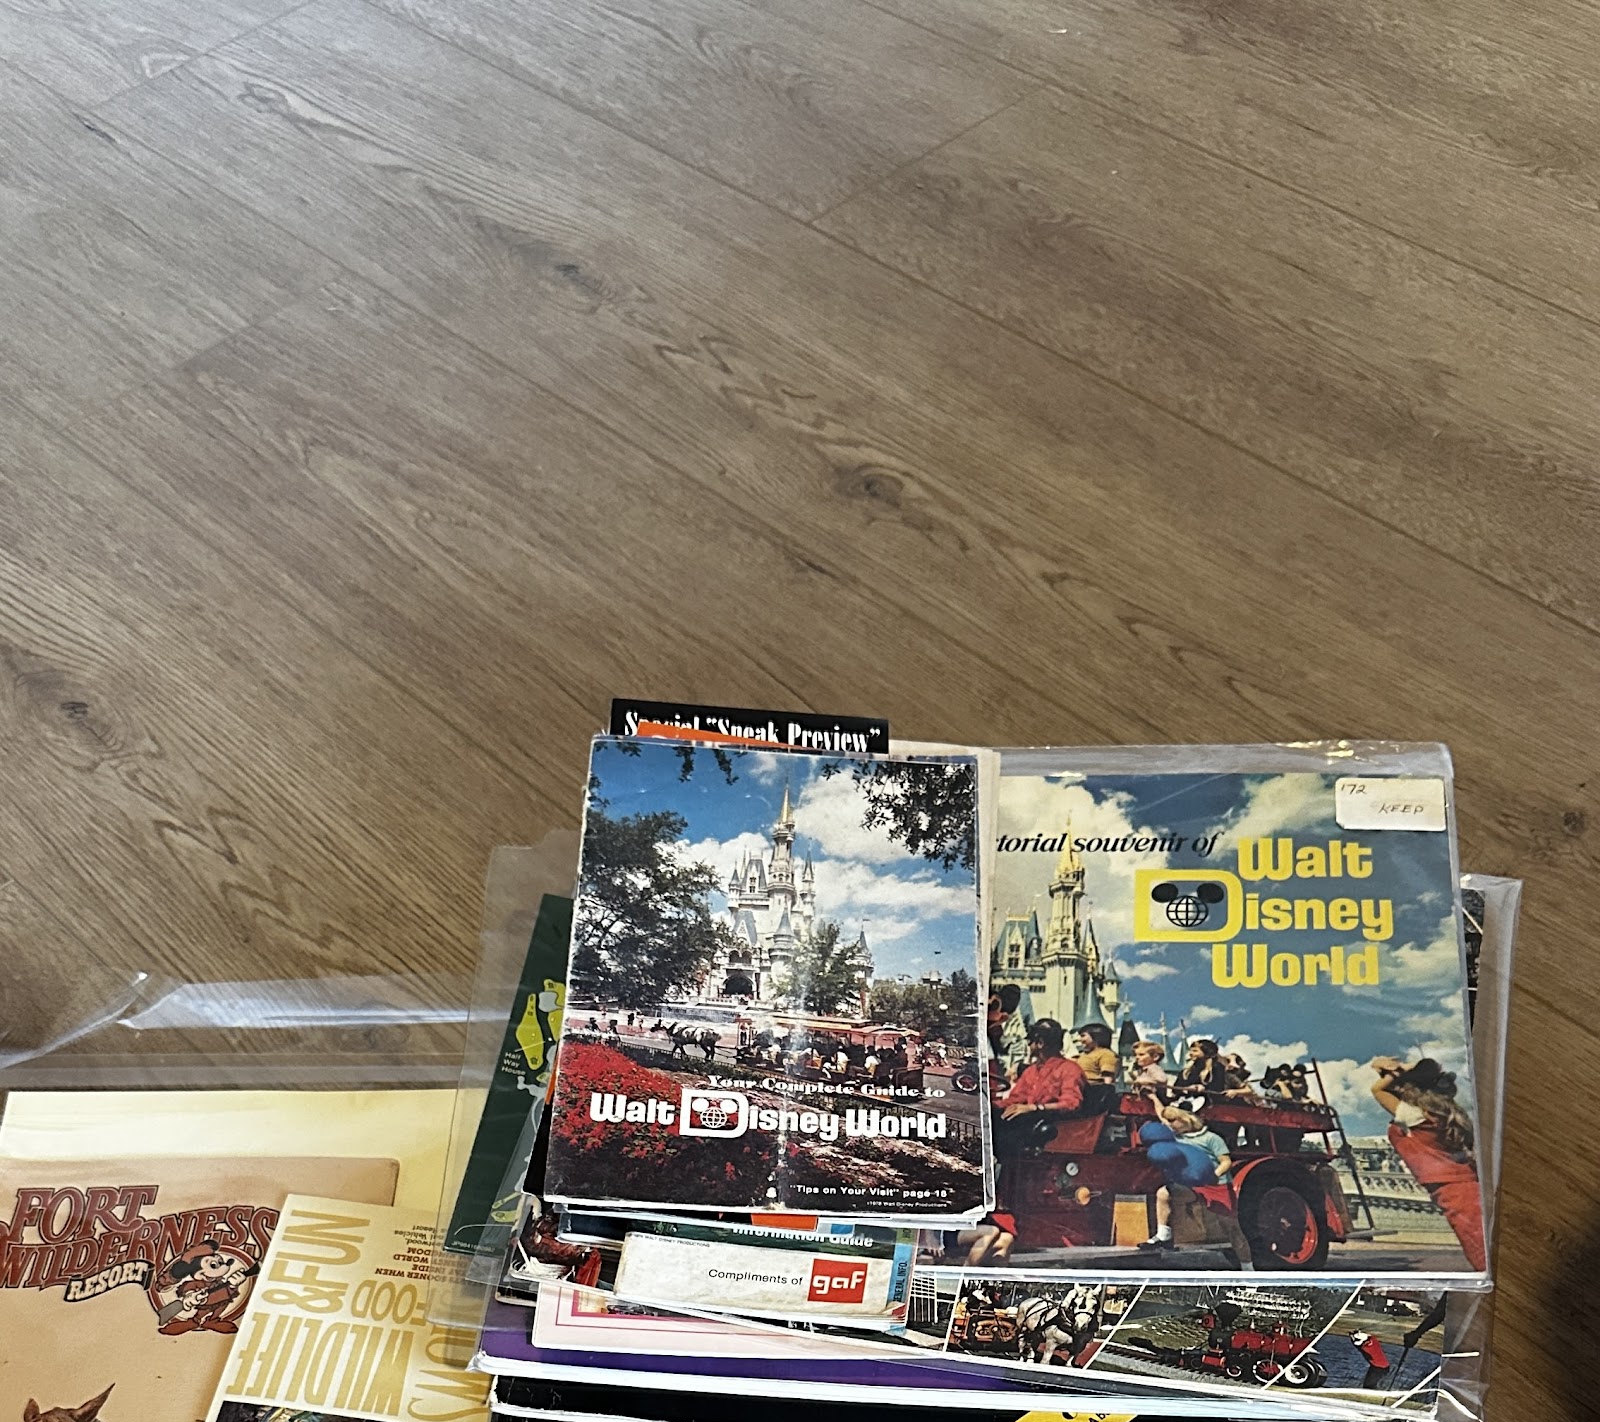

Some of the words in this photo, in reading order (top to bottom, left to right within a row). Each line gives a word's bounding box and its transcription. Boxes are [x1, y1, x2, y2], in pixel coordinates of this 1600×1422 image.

[1378, 803, 1424, 815] KEEP
[995, 833, 1068, 853] torial
[1071, 833, 1189, 853] souvenir
[1191, 831, 1225, 858] of
[1236, 836, 1373, 881] Walt
[1134, 868, 1394, 943] Disney
[1211, 942, 1379, 989] World
[501, 1066, 526, 1076] House
[503, 1058, 520, 1069] Way
[706, 1073, 758, 1090] Your
[758, 1077, 855, 1097] Complete
[860, 1082, 921, 1098] Guide
[923, 1086, 946, 1099] to
[588, 1091, 676, 1126] Walt
[679, 1088, 839, 1141] Disney
[844, 1108, 947, 1140] World
[822, 1186, 837, 1195] on
[840, 1186, 866, 1196] Your
[902, 1188, 931, 1199] page
[9, 1184, 160, 1245] FORT
[0, 1205, 281, 1291] WILDERNESS
[394, 1229, 427, 1240] Vehicles
[267, 1209, 371, 1291] FUN
[393, 1253, 429, 1264] WORLD
[66, 1261, 149, 1301] RESORT
[375, 1267, 405, 1278] WHEN
[707, 1268, 788, 1286] Compliments
[791, 1275, 804, 1286] of
[812, 1270, 865, 1295] gaf
[224, 1311, 415, 1417] WILDLIFE
